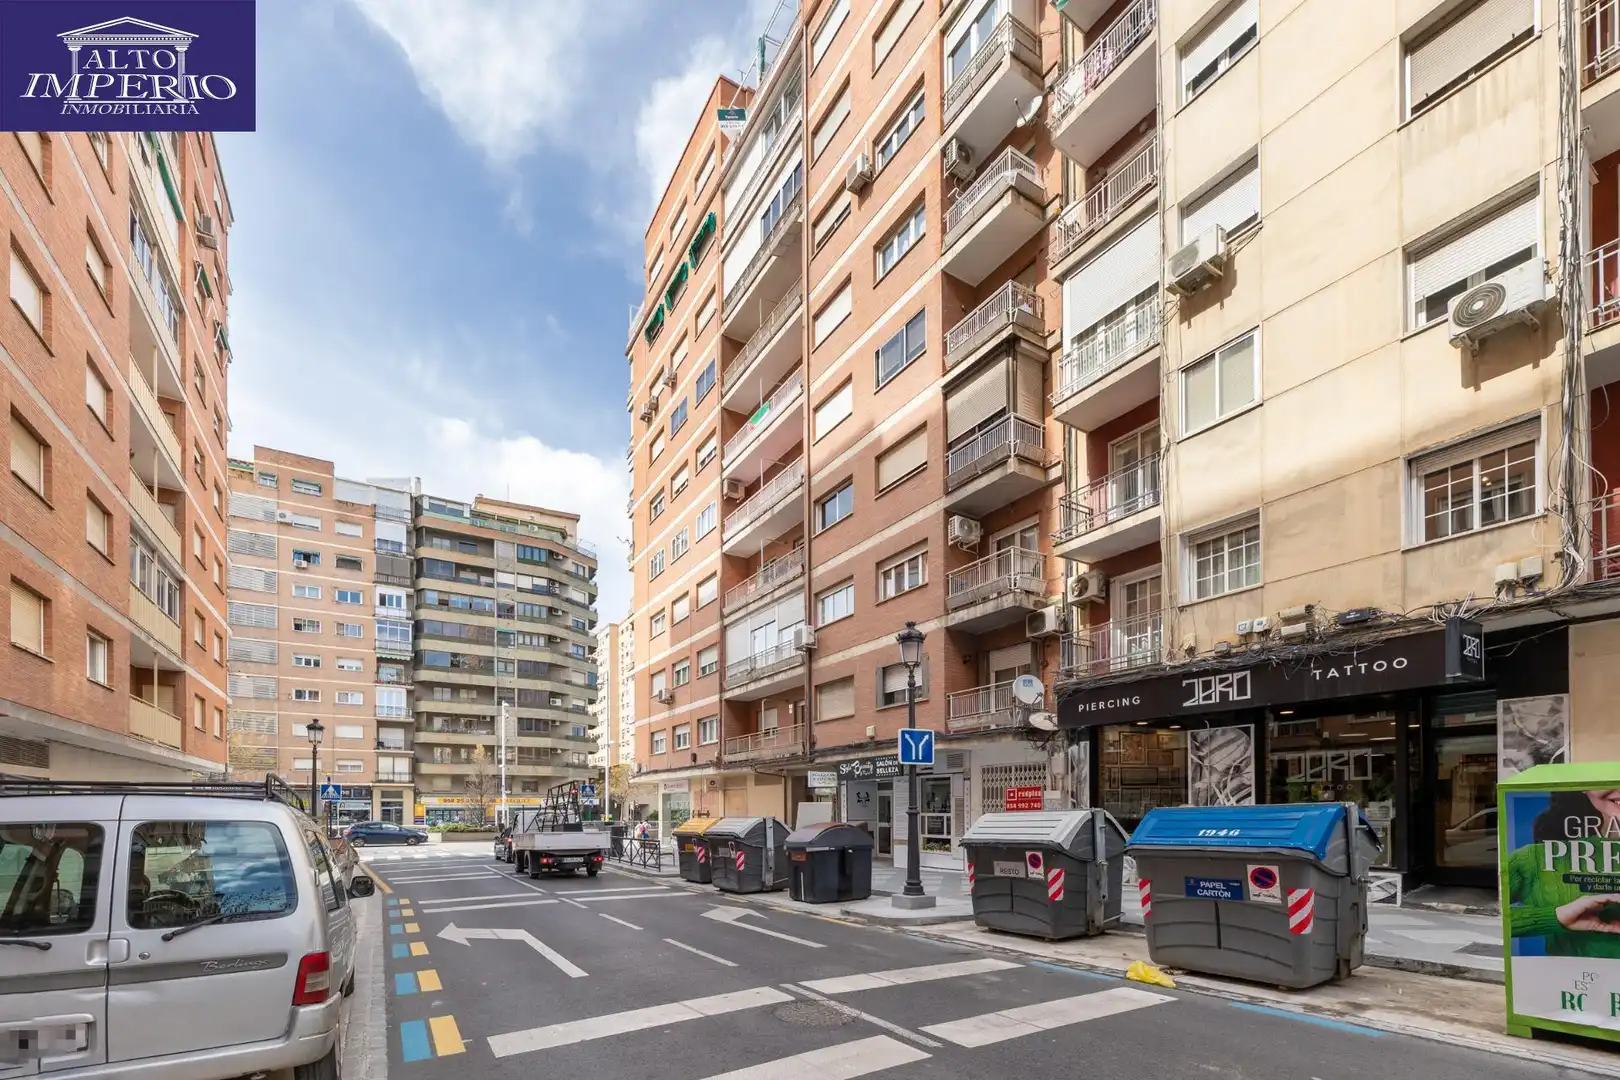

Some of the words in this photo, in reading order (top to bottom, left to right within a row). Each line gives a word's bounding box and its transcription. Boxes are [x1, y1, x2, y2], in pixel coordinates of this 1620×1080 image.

[1078, 695, 1141, 713] PIERCING
[1182, 670, 1252, 707] ZERO
[1312, 657, 1408, 680] TATTOO
[876, 766, 899, 774] BELLEZA
[1197, 829, 1241, 837] 1946
[1000, 867, 1020, 876] RESTO
[1199, 881, 1227, 889] PAPEL
[1196, 888, 1231, 898] CARTÓN
[200, 957, 269, 973] Berlingo
